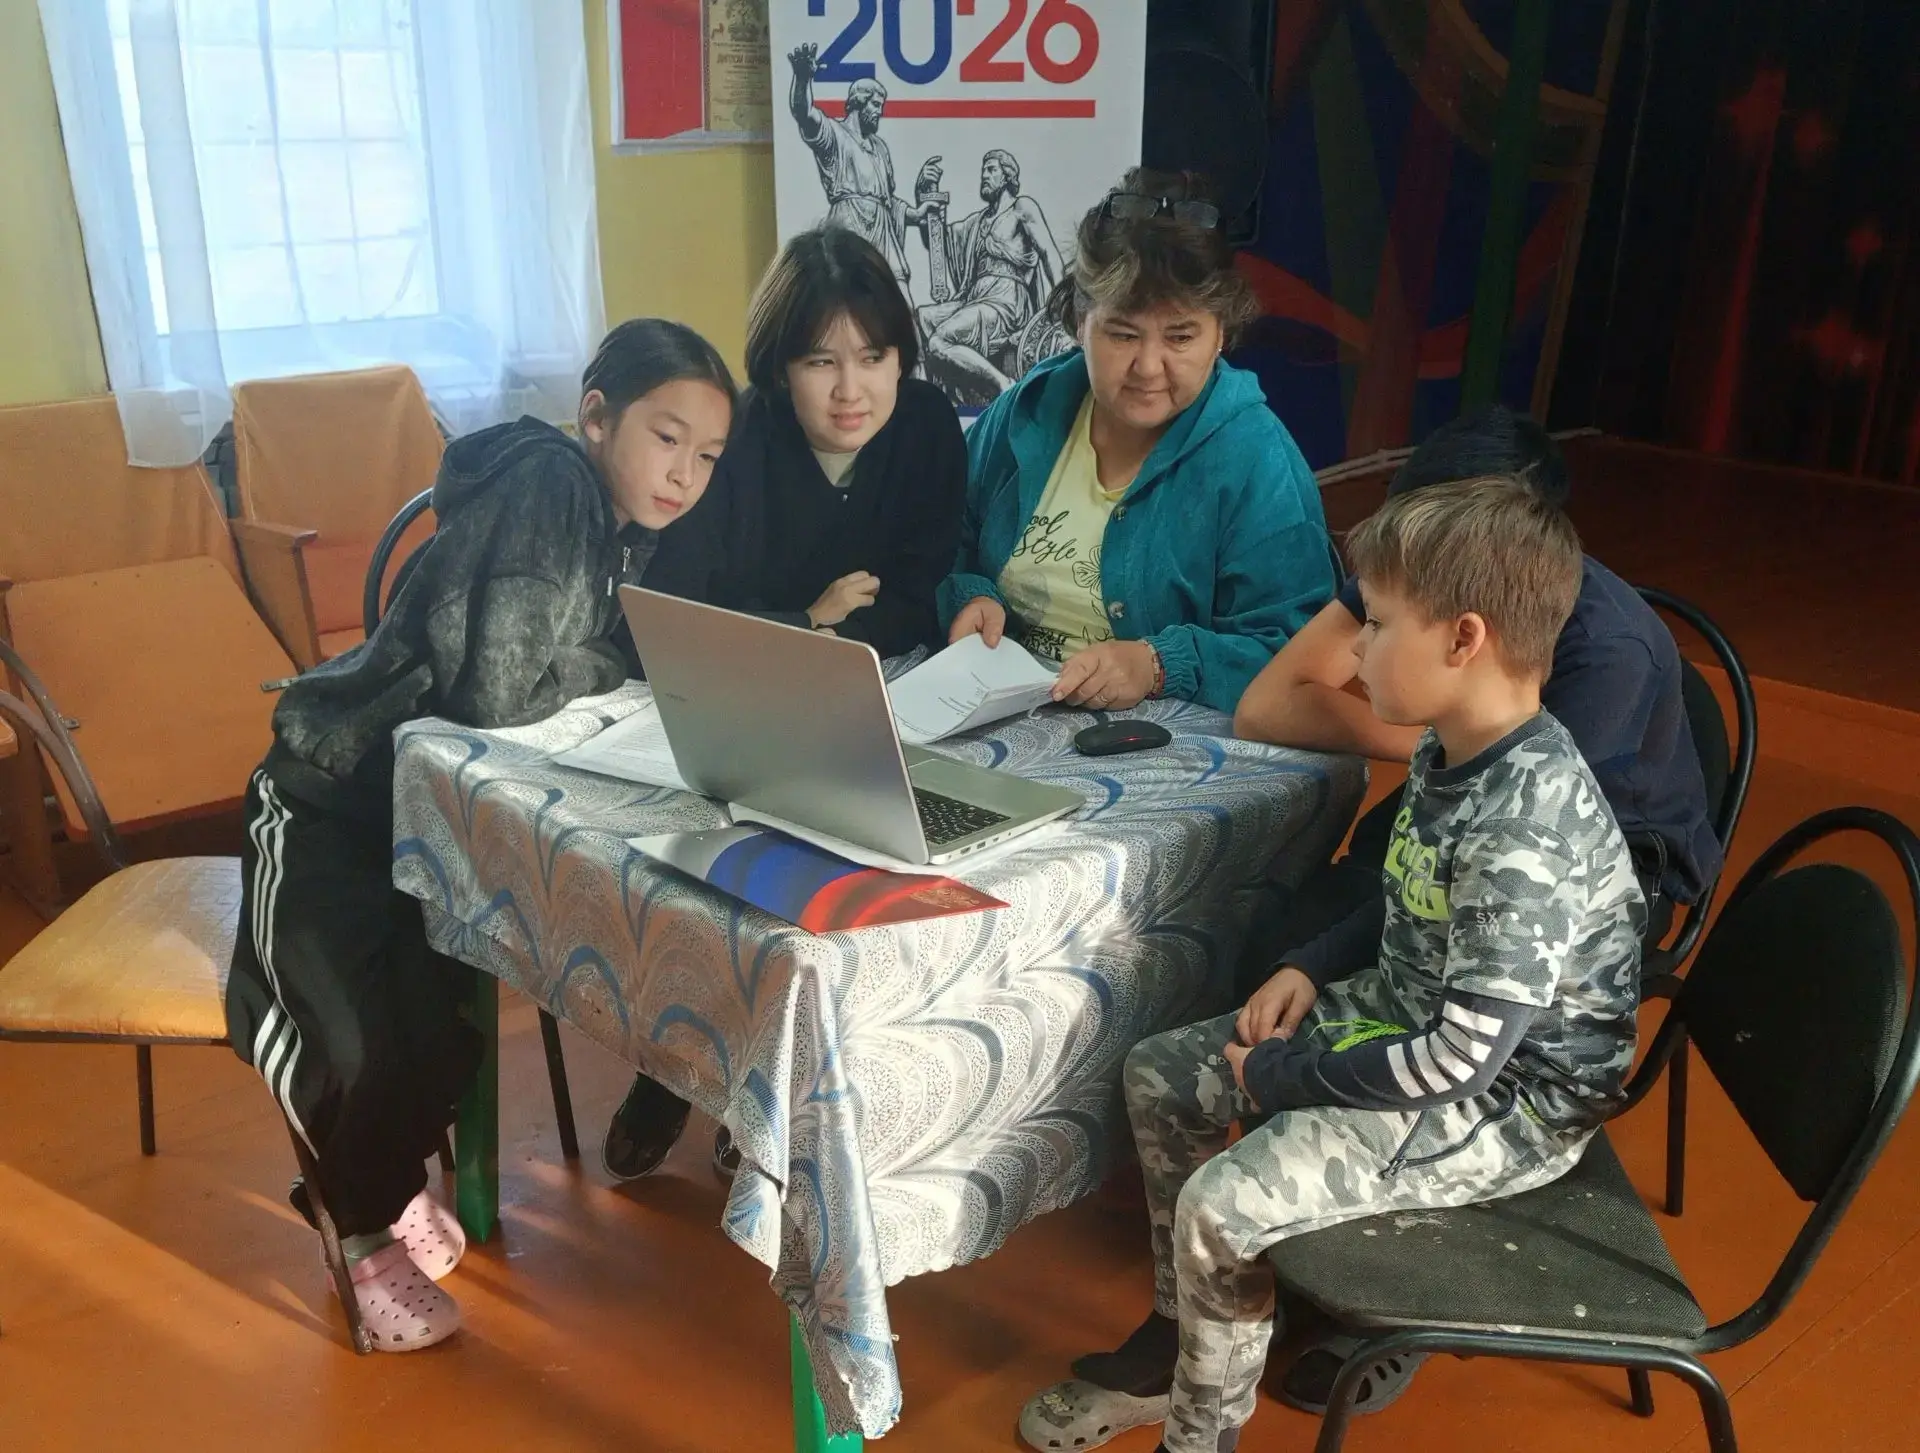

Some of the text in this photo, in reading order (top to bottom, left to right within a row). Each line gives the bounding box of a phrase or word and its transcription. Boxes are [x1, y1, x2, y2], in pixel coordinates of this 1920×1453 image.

[808, 0, 1099, 84] 2026
[1028, 510, 1070, 535] ool
[1011, 526, 1078, 565] Style
[1475, 911, 1498, 924] SX
[1475, 924, 1500, 936] TW
